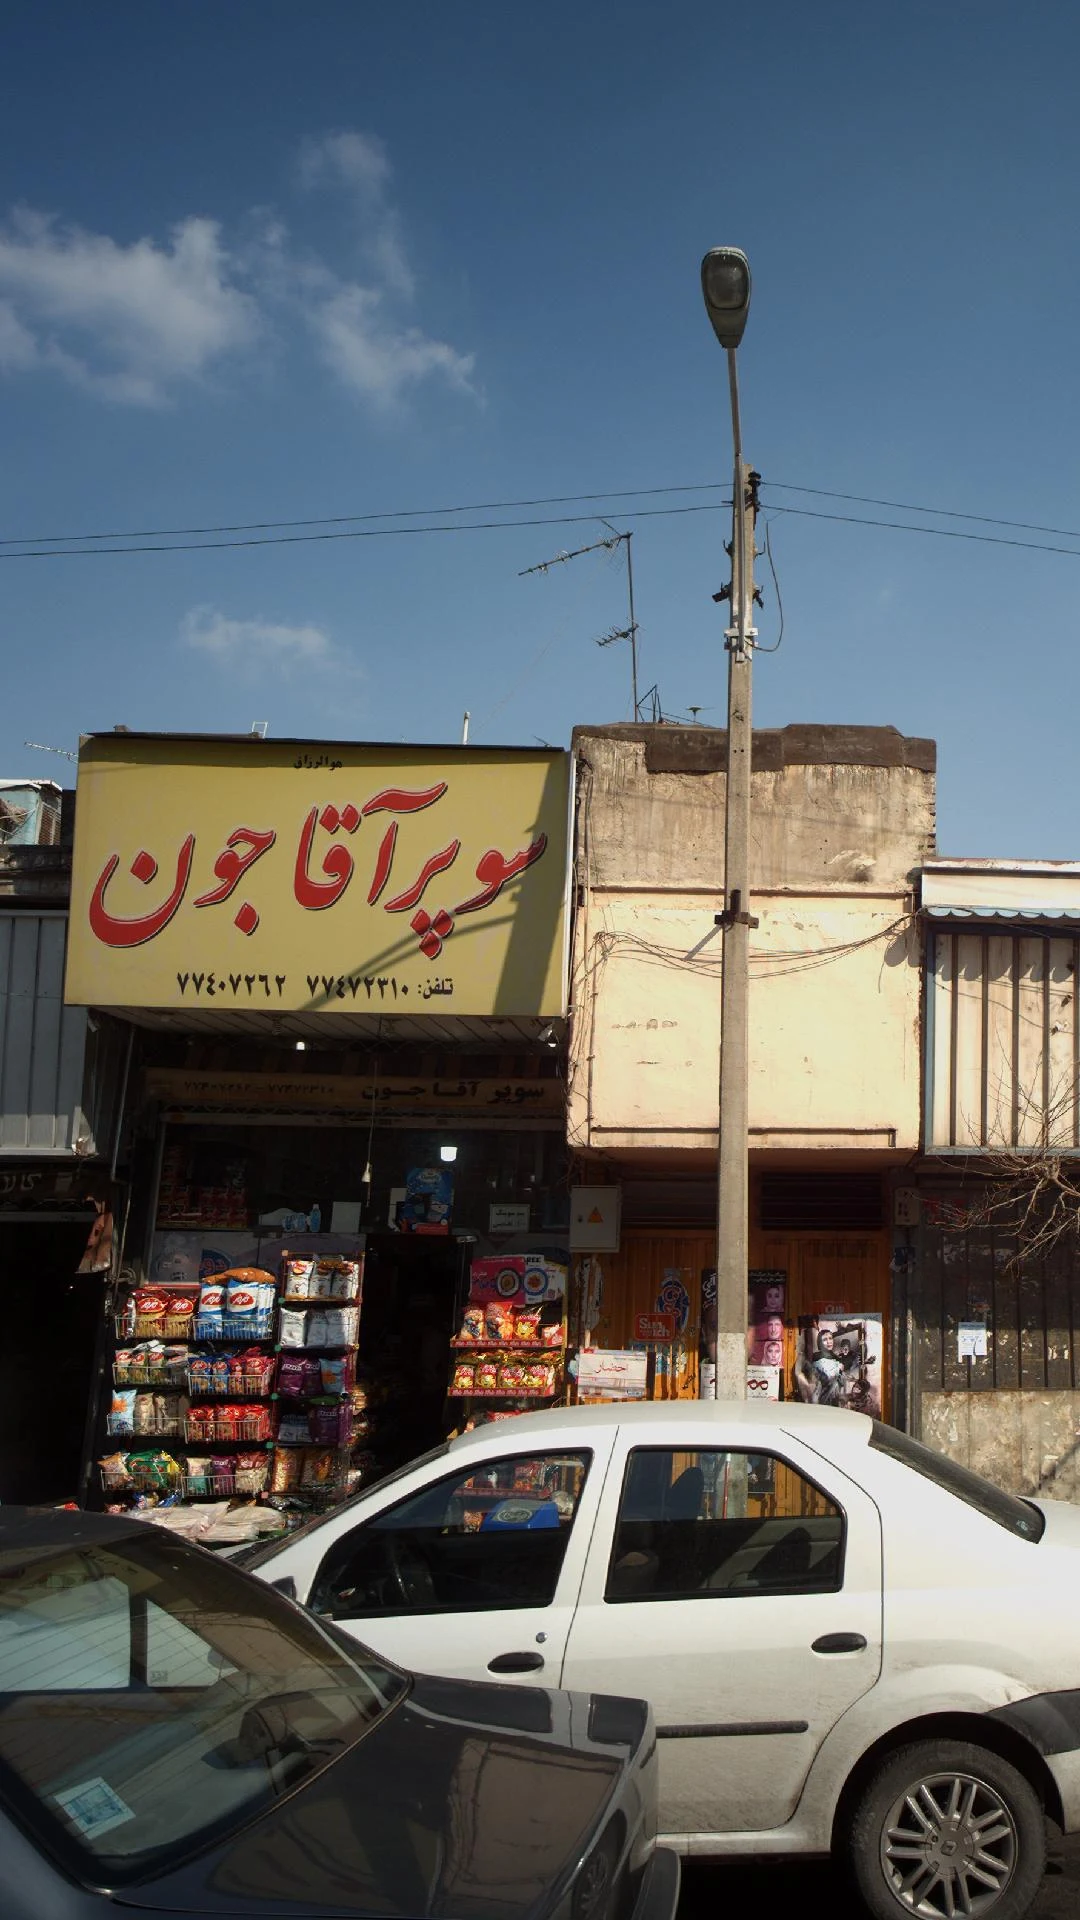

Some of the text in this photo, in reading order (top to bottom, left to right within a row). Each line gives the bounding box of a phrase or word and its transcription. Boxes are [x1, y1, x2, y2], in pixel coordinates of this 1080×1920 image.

[89, 782, 548, 960] سوپر آقا جون
[417, 977, 455, 997] تلفن:
[433, 1080, 482, 1097] آقا
